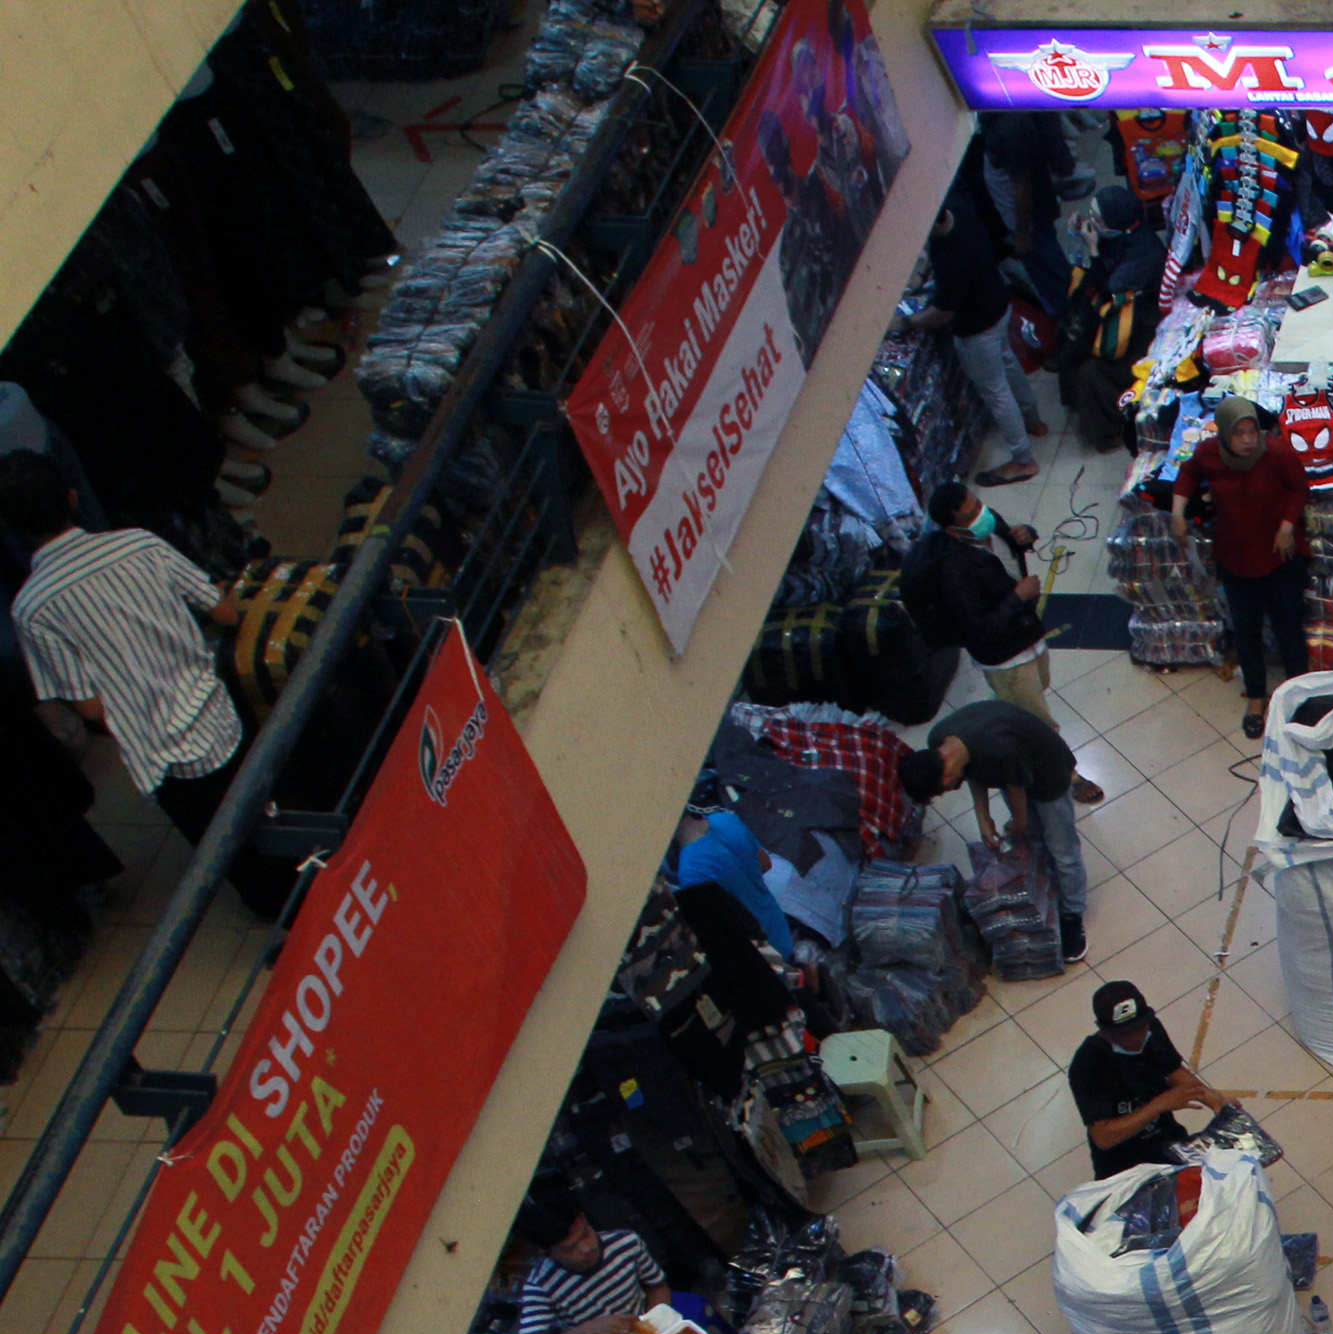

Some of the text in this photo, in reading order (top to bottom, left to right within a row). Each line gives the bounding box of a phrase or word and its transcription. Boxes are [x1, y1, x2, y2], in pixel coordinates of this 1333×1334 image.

[1037, 66, 1098, 88] MJR
[1248, 92, 1295, 102] LANTAI
[612, 192, 768, 511] Ayo Pakai Masker!
[1286, 406, 1331, 424] SPIDER-MAN
[648, 321, 782, 609] #JakselSehat
[204, 1109, 264, 1208] DI
[246, 857, 401, 1126] SHOPEE,
[332, 1088, 385, 1187] PRODUK
[216, 1246, 256, 1301] 1
